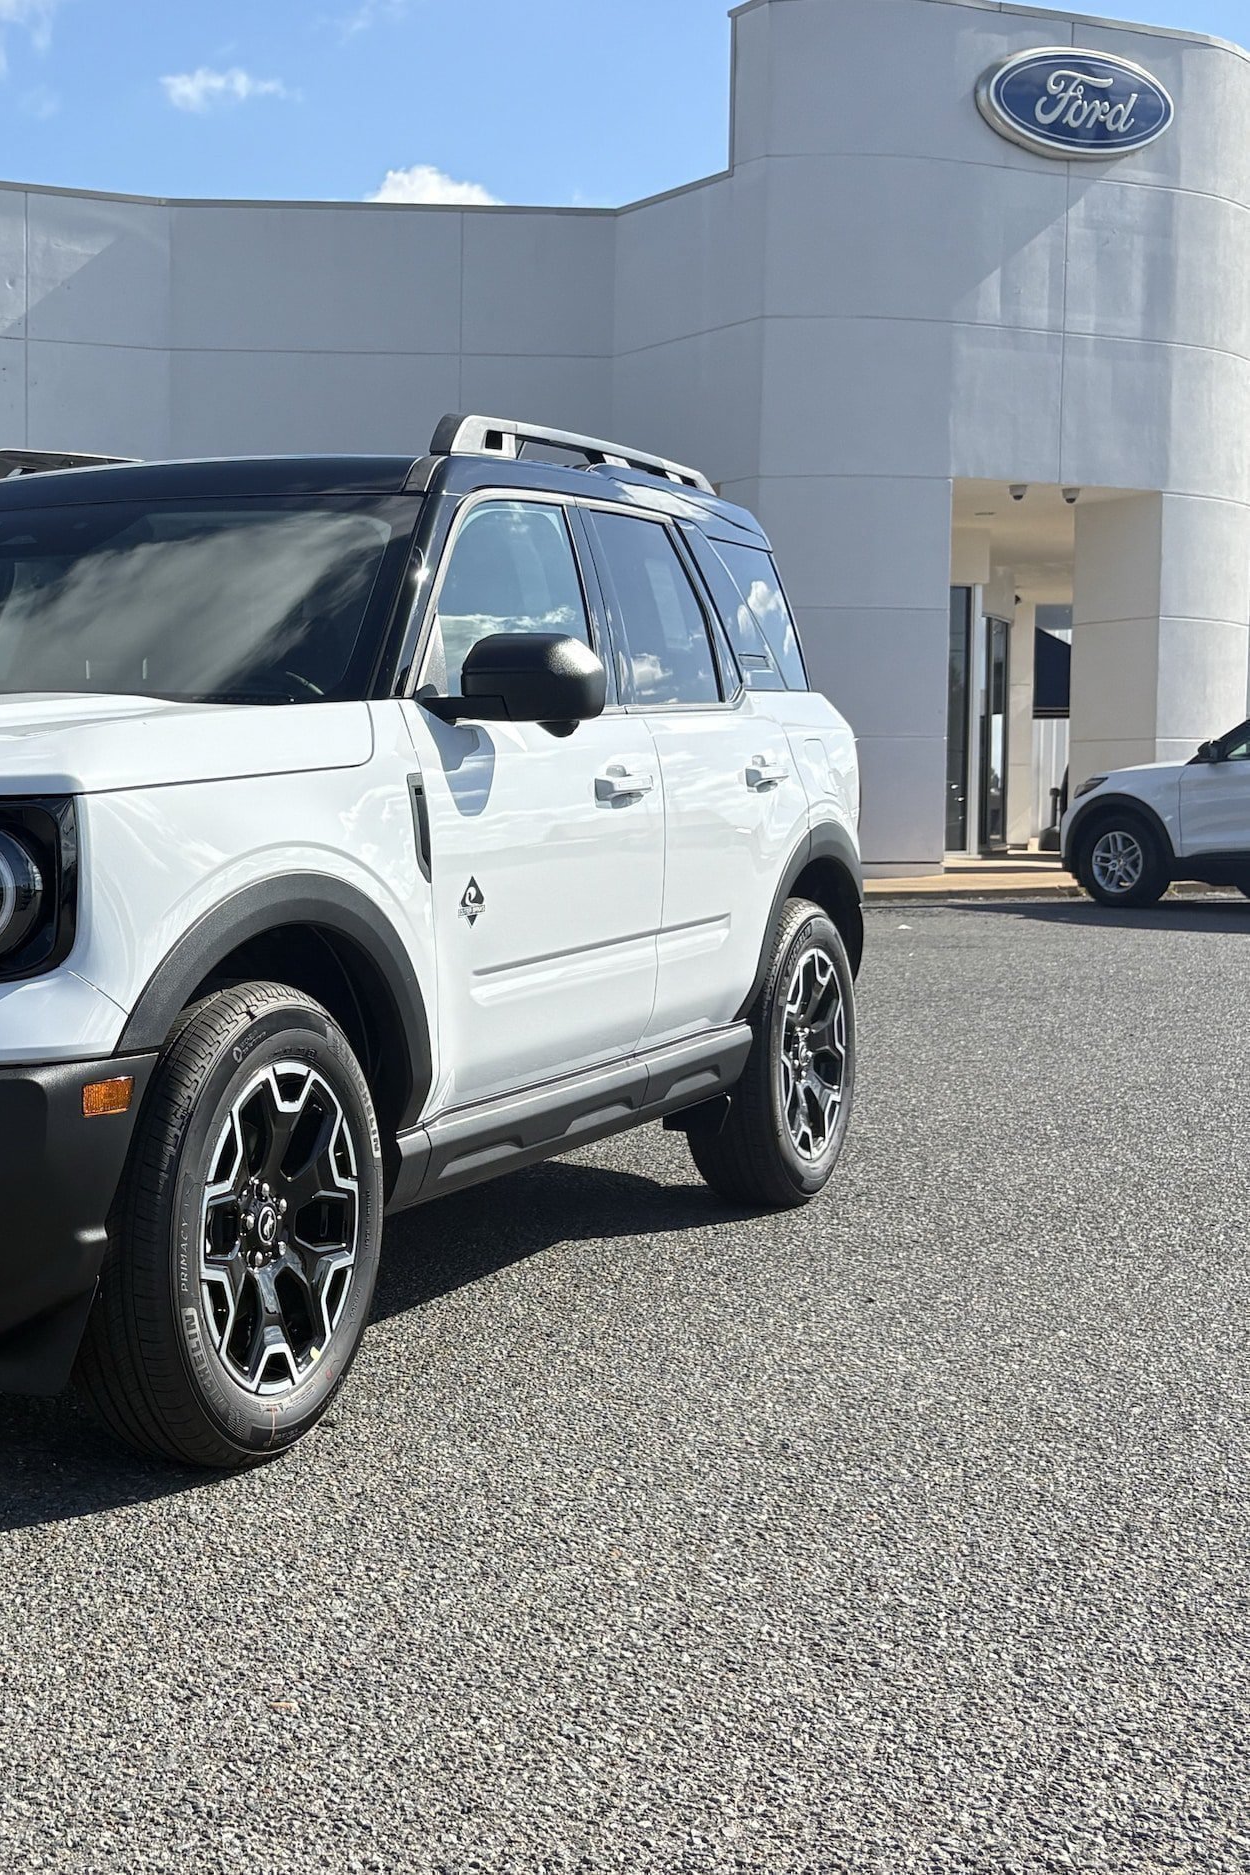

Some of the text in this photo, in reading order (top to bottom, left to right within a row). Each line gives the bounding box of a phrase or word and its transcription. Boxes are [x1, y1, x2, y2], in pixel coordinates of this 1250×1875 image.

[1035, 70, 1138, 133] Ford
[180, 1218, 189, 1292] PRIMACY
[184, 1314, 231, 1409] MICHELIN
